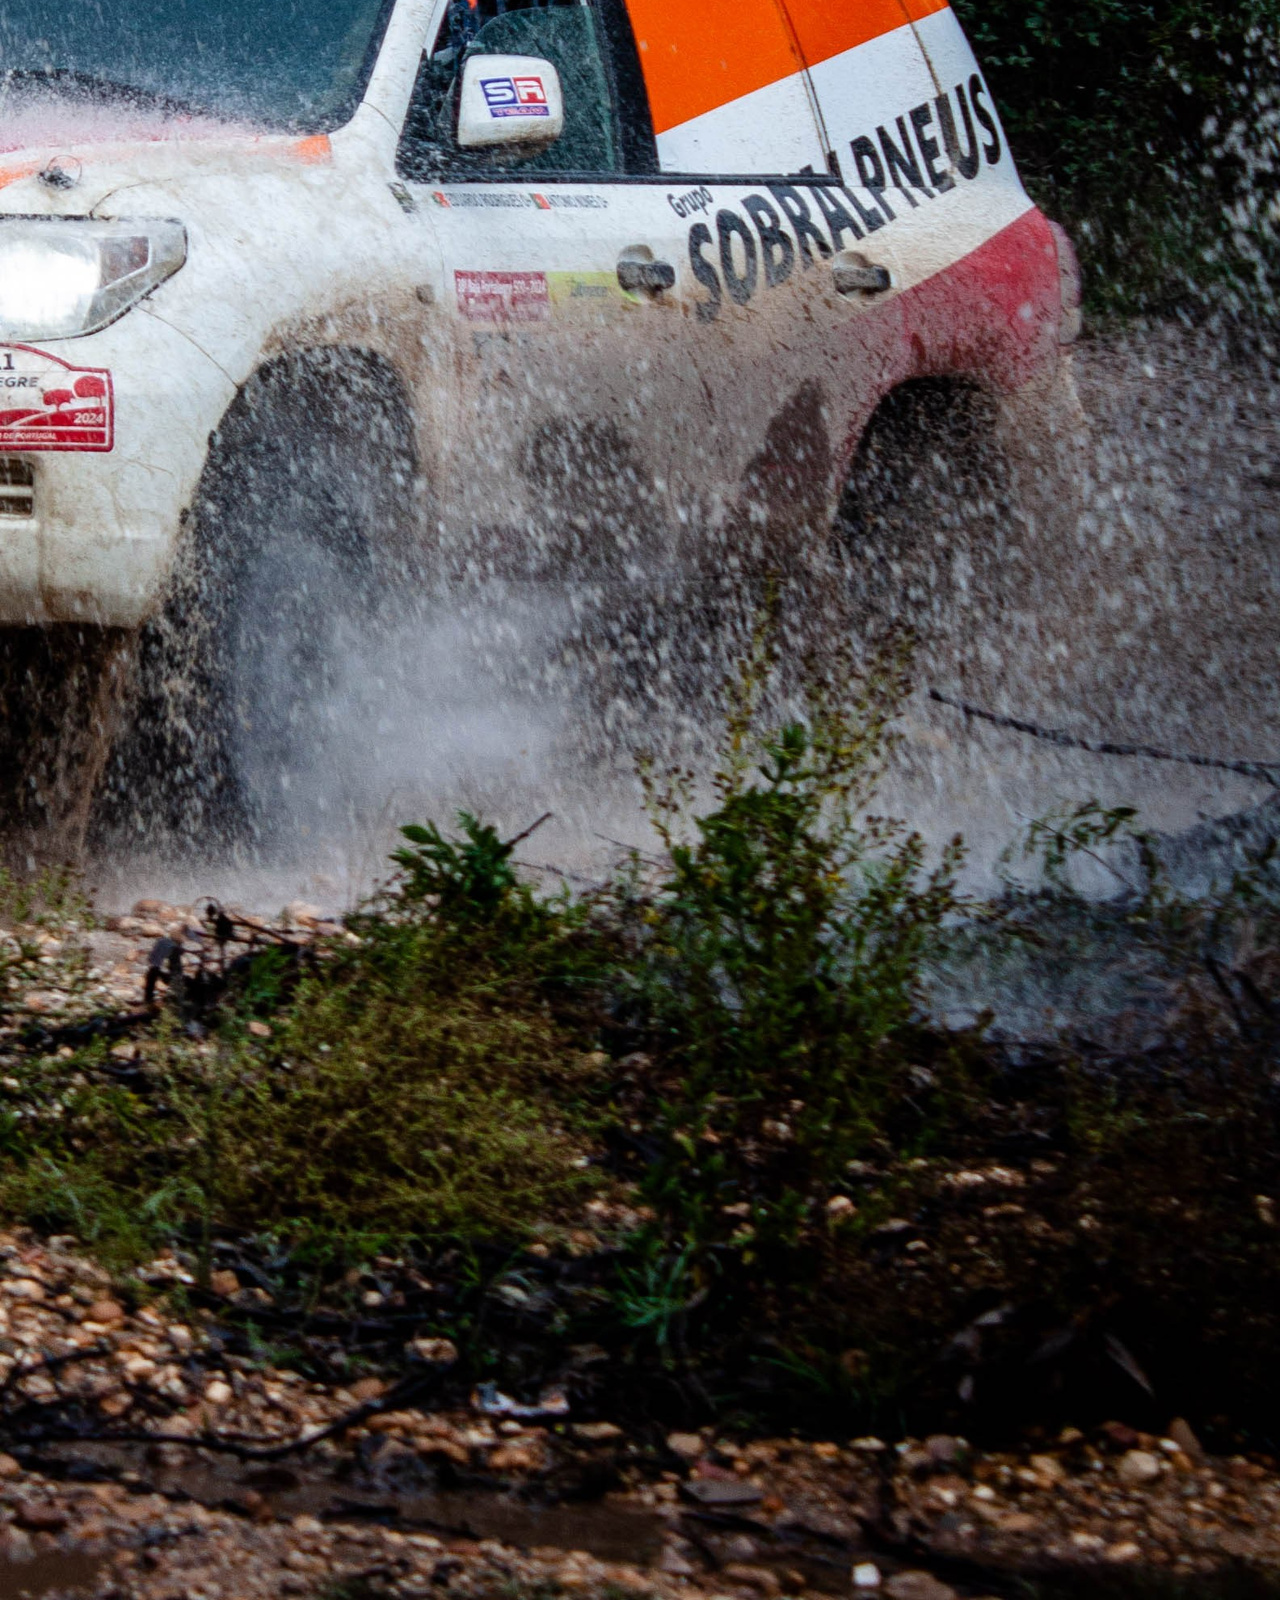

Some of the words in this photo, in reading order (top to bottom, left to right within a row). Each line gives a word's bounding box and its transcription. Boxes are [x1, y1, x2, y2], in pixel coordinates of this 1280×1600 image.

[666, 185, 714, 219] Grupo
[688, 73, 1002, 324] SOBRALPNEUS
[73, 411, 104, 425] 2024
[3, 431, 15, 441] DE
[15, 431, 58, 442] PORTUGAL
